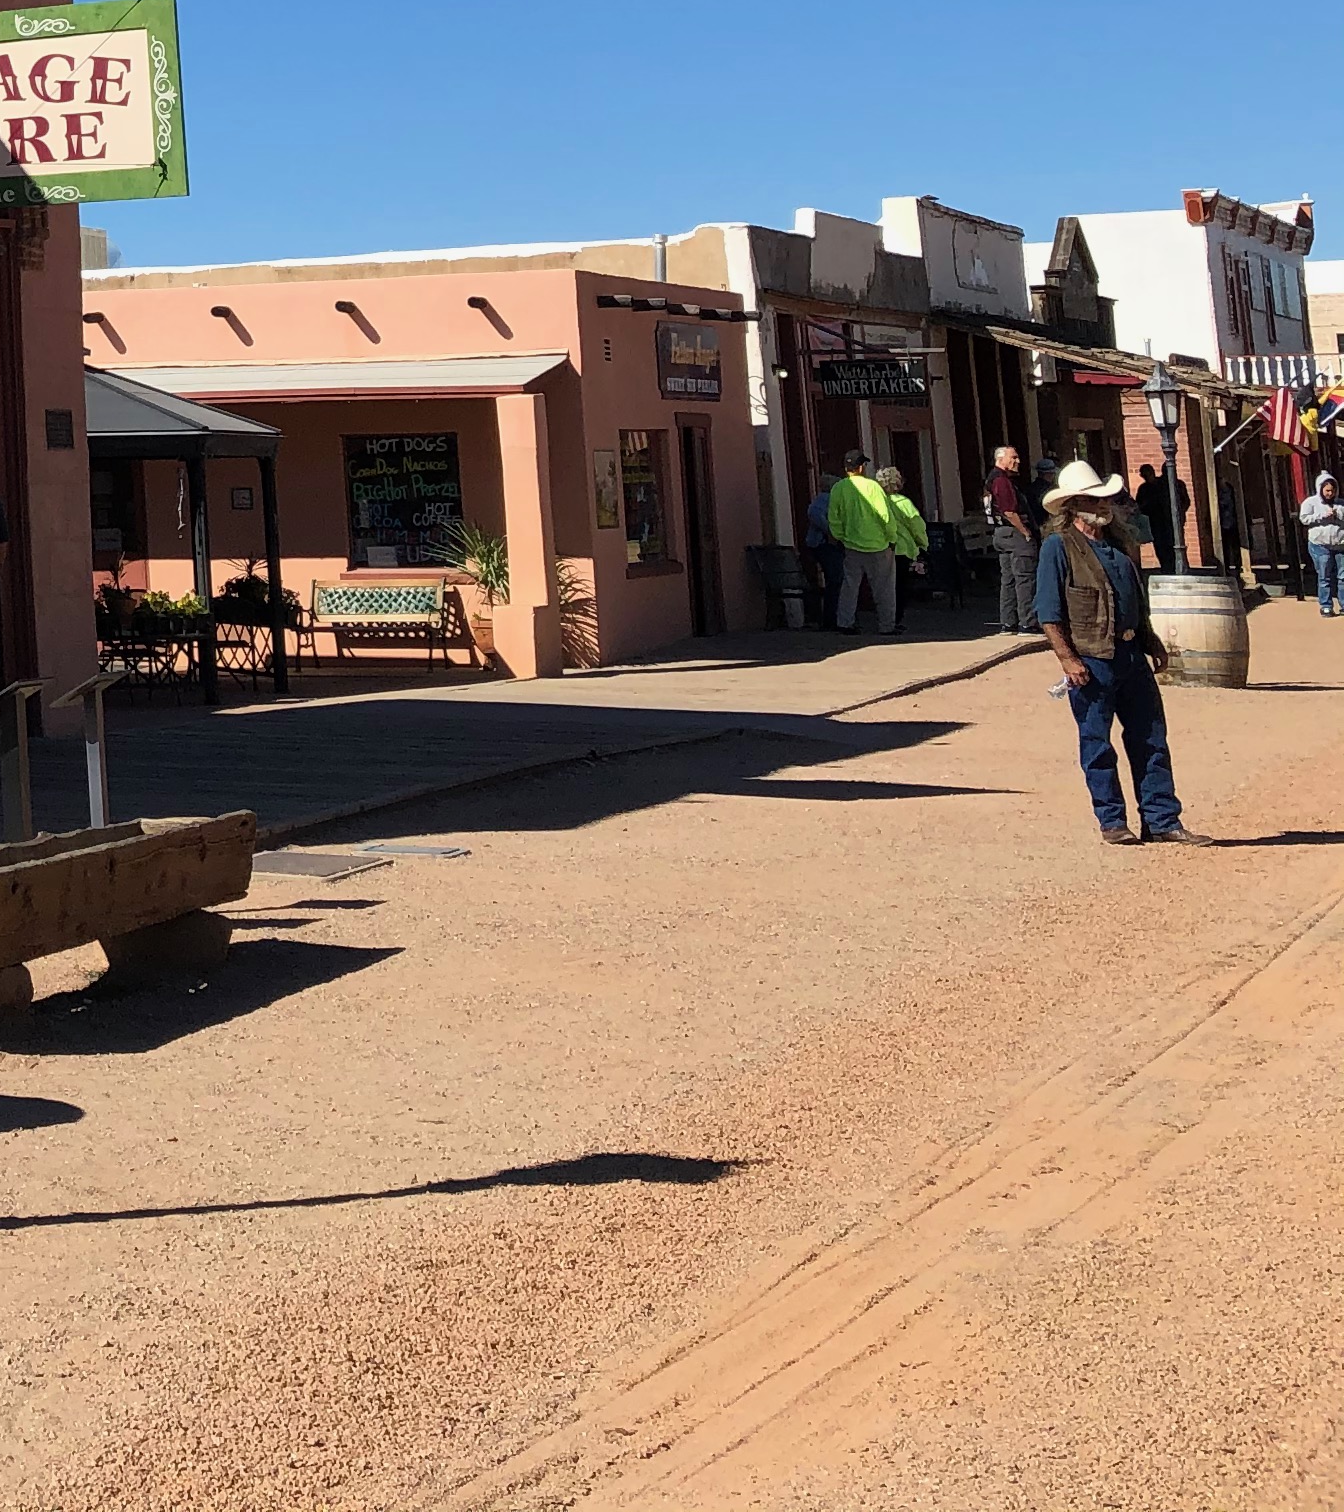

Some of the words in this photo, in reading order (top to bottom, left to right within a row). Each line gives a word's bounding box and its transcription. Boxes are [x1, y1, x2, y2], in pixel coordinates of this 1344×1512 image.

[823, 377, 925, 396] UNDERTAKERS
[366, 438, 399, 455] HOT
[403, 436, 448, 453] DOGS
[424, 502, 454, 516] HOT
